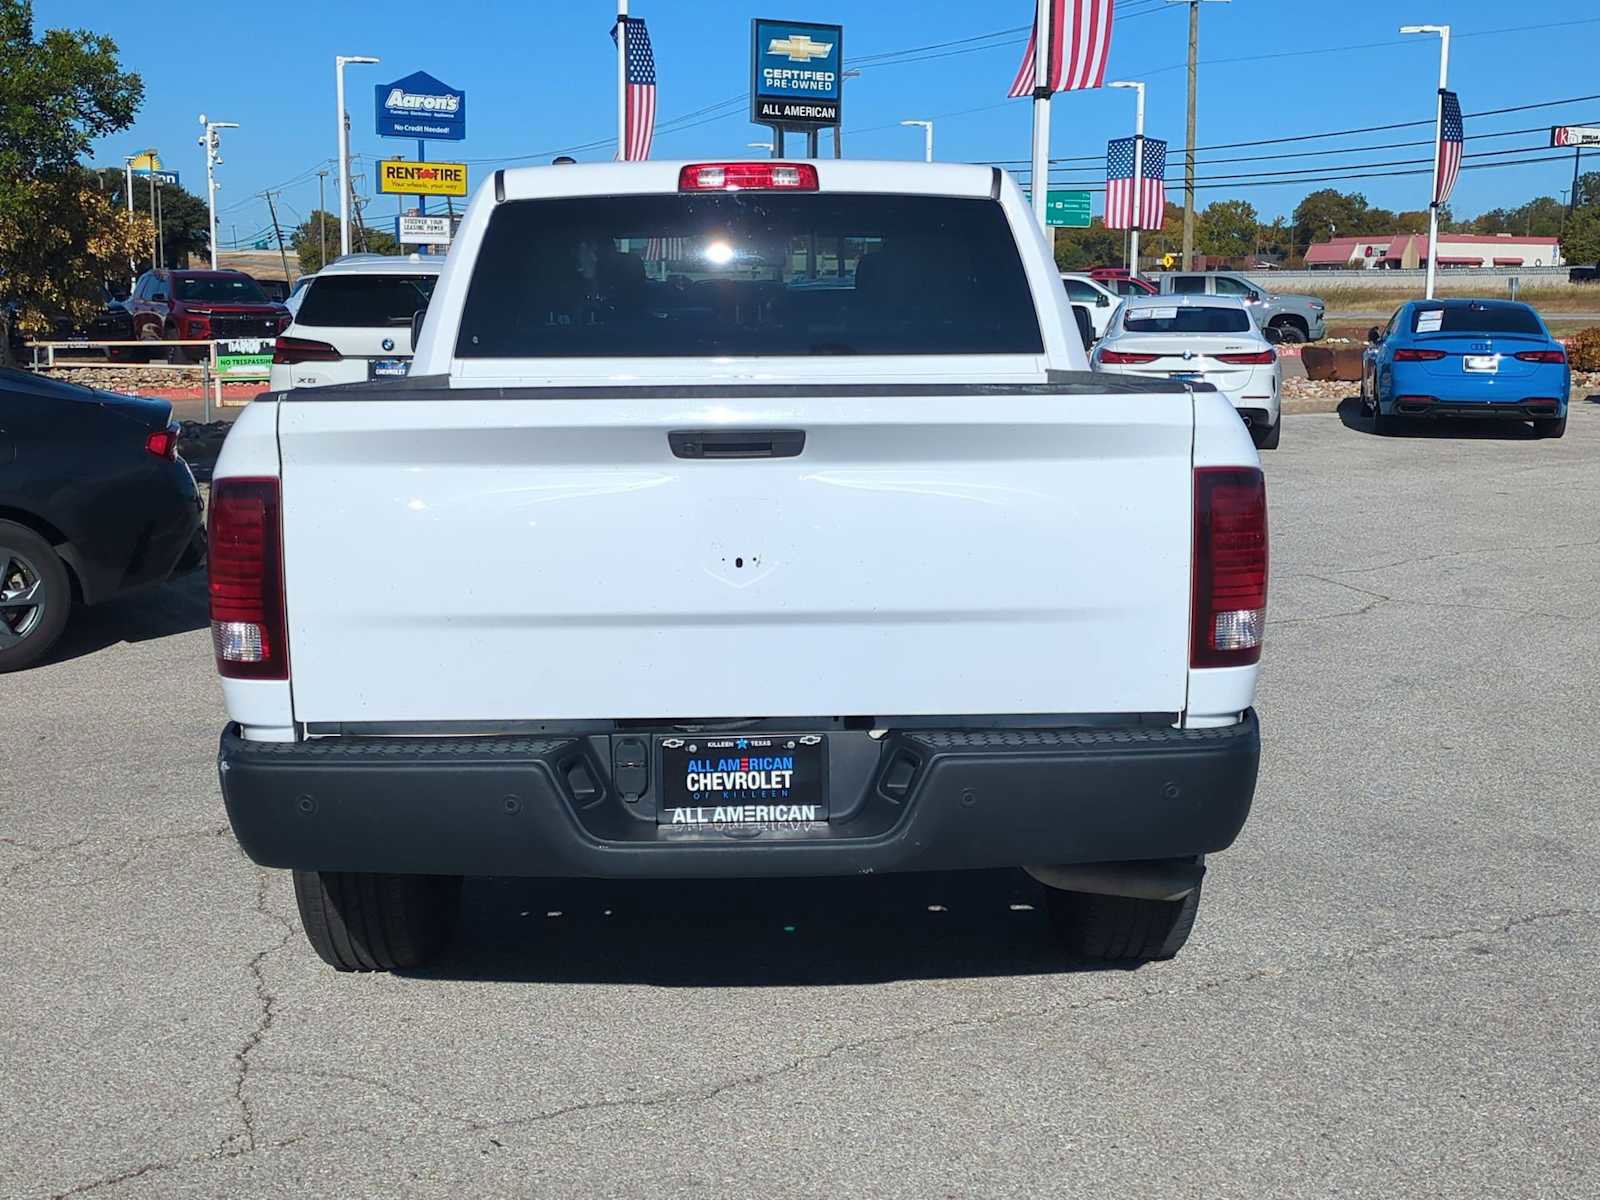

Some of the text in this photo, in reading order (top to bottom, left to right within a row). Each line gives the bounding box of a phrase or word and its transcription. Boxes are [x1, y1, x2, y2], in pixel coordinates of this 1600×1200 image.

[763, 68, 835, 81] CERTIFIED
[766, 79, 832, 91] PRE-OWNED
[385, 88, 460, 113] Aaron's
[762, 104, 836, 118] ALL AMERICAN
[424, 126, 450, 134] Needed!
[386, 166, 462, 182] RENT TIRE
[688, 757, 793, 773] ALL AMERICAN
[686, 771, 793, 792] CHEVROLET
[693, 790, 790, 800] OF KILLEEN
[672, 805, 815, 824] ALL AMERICAN
